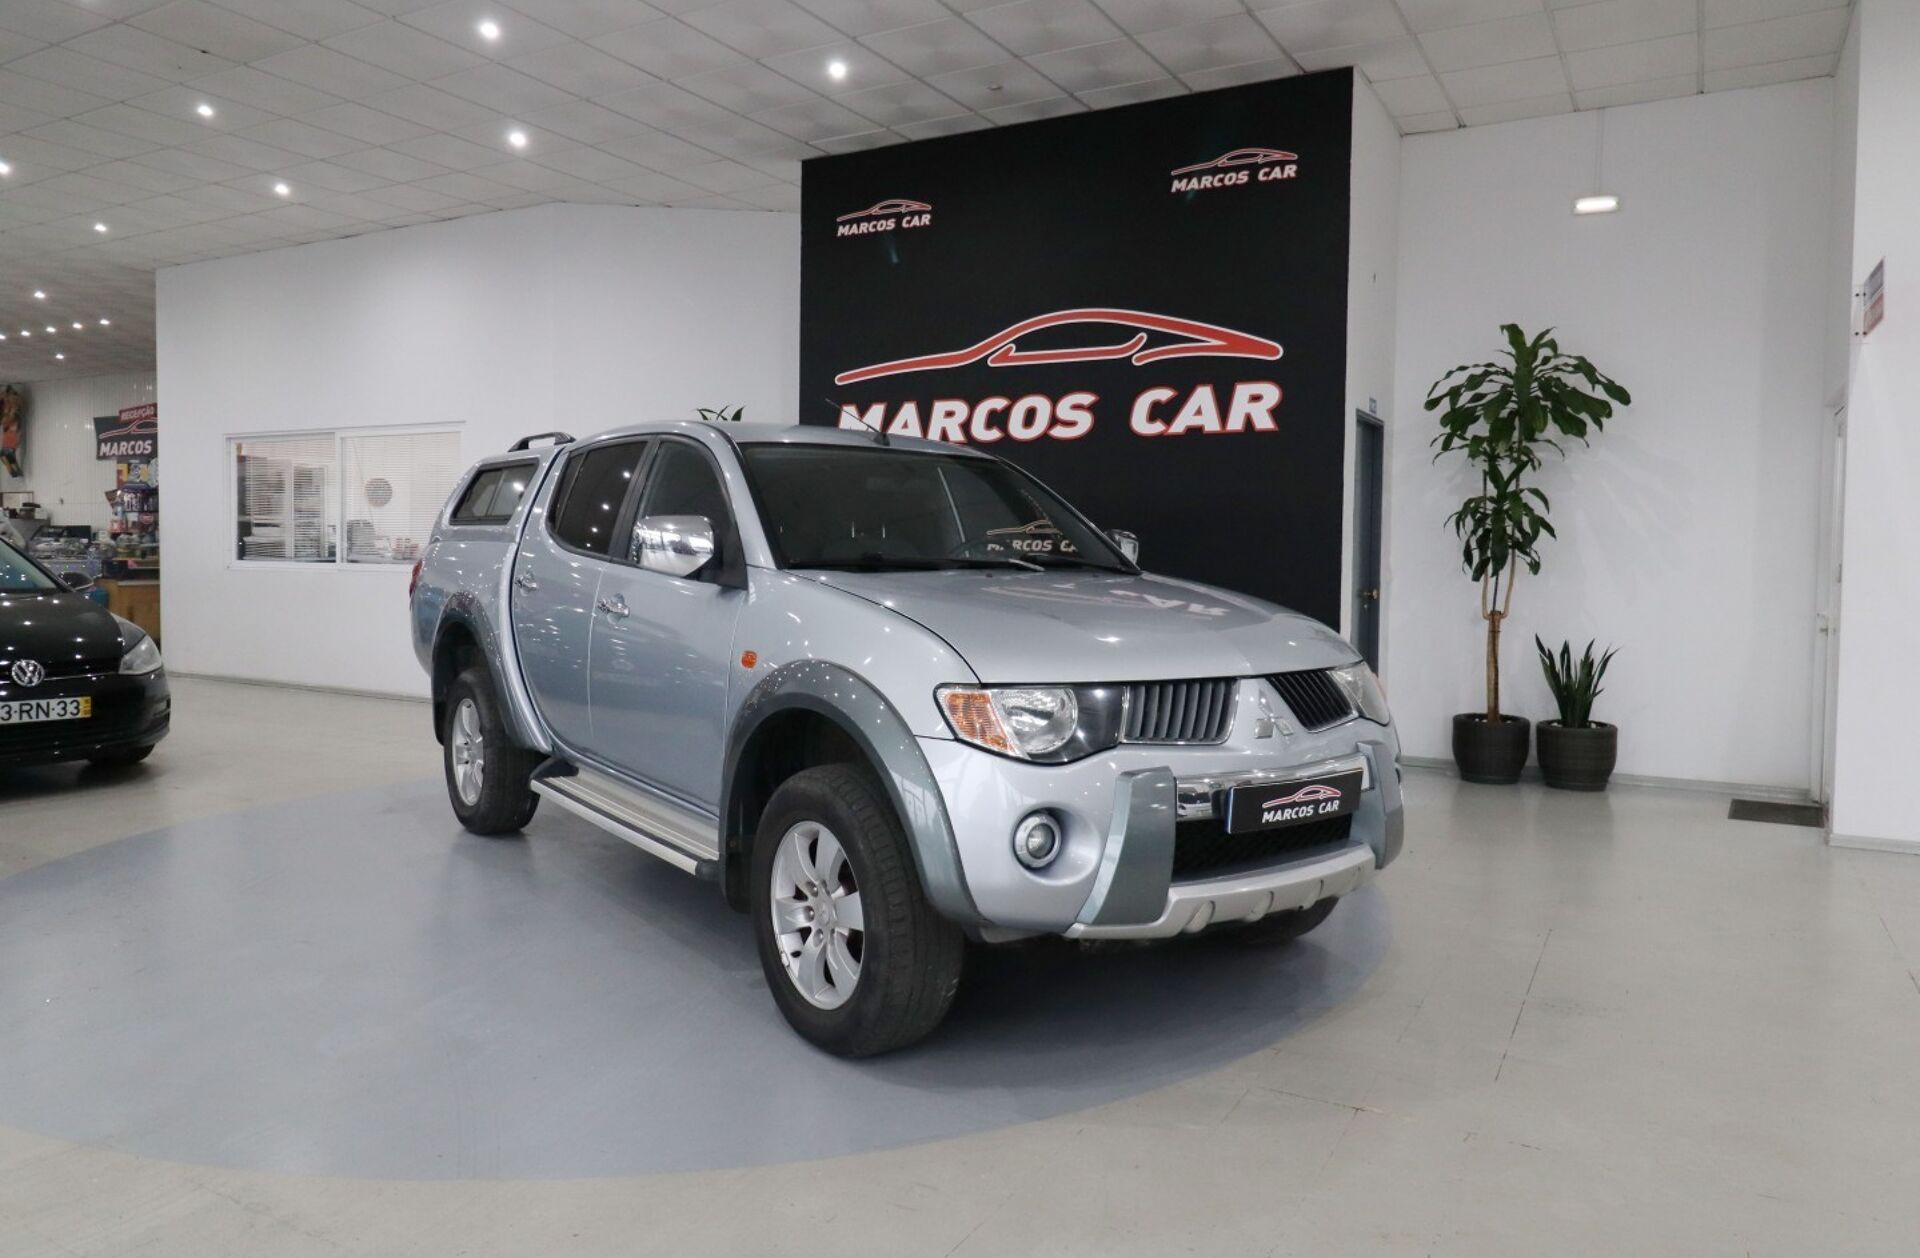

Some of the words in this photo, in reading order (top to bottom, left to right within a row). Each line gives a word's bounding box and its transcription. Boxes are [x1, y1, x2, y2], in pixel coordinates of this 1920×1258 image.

[1171, 170, 1250, 193] MARCOS
[1258, 164, 1297, 181] CAR
[837, 218, 896, 237] MARCOS
[902, 213, 931, 228] CAR
[838, 391, 1099, 444] MARCOS
[1129, 380, 1282, 436] CAR
[99, 440, 153, 457] MARCOS
[1261, 804, 1315, 824] MARCOS
[1318, 799, 1340, 814] CAR
